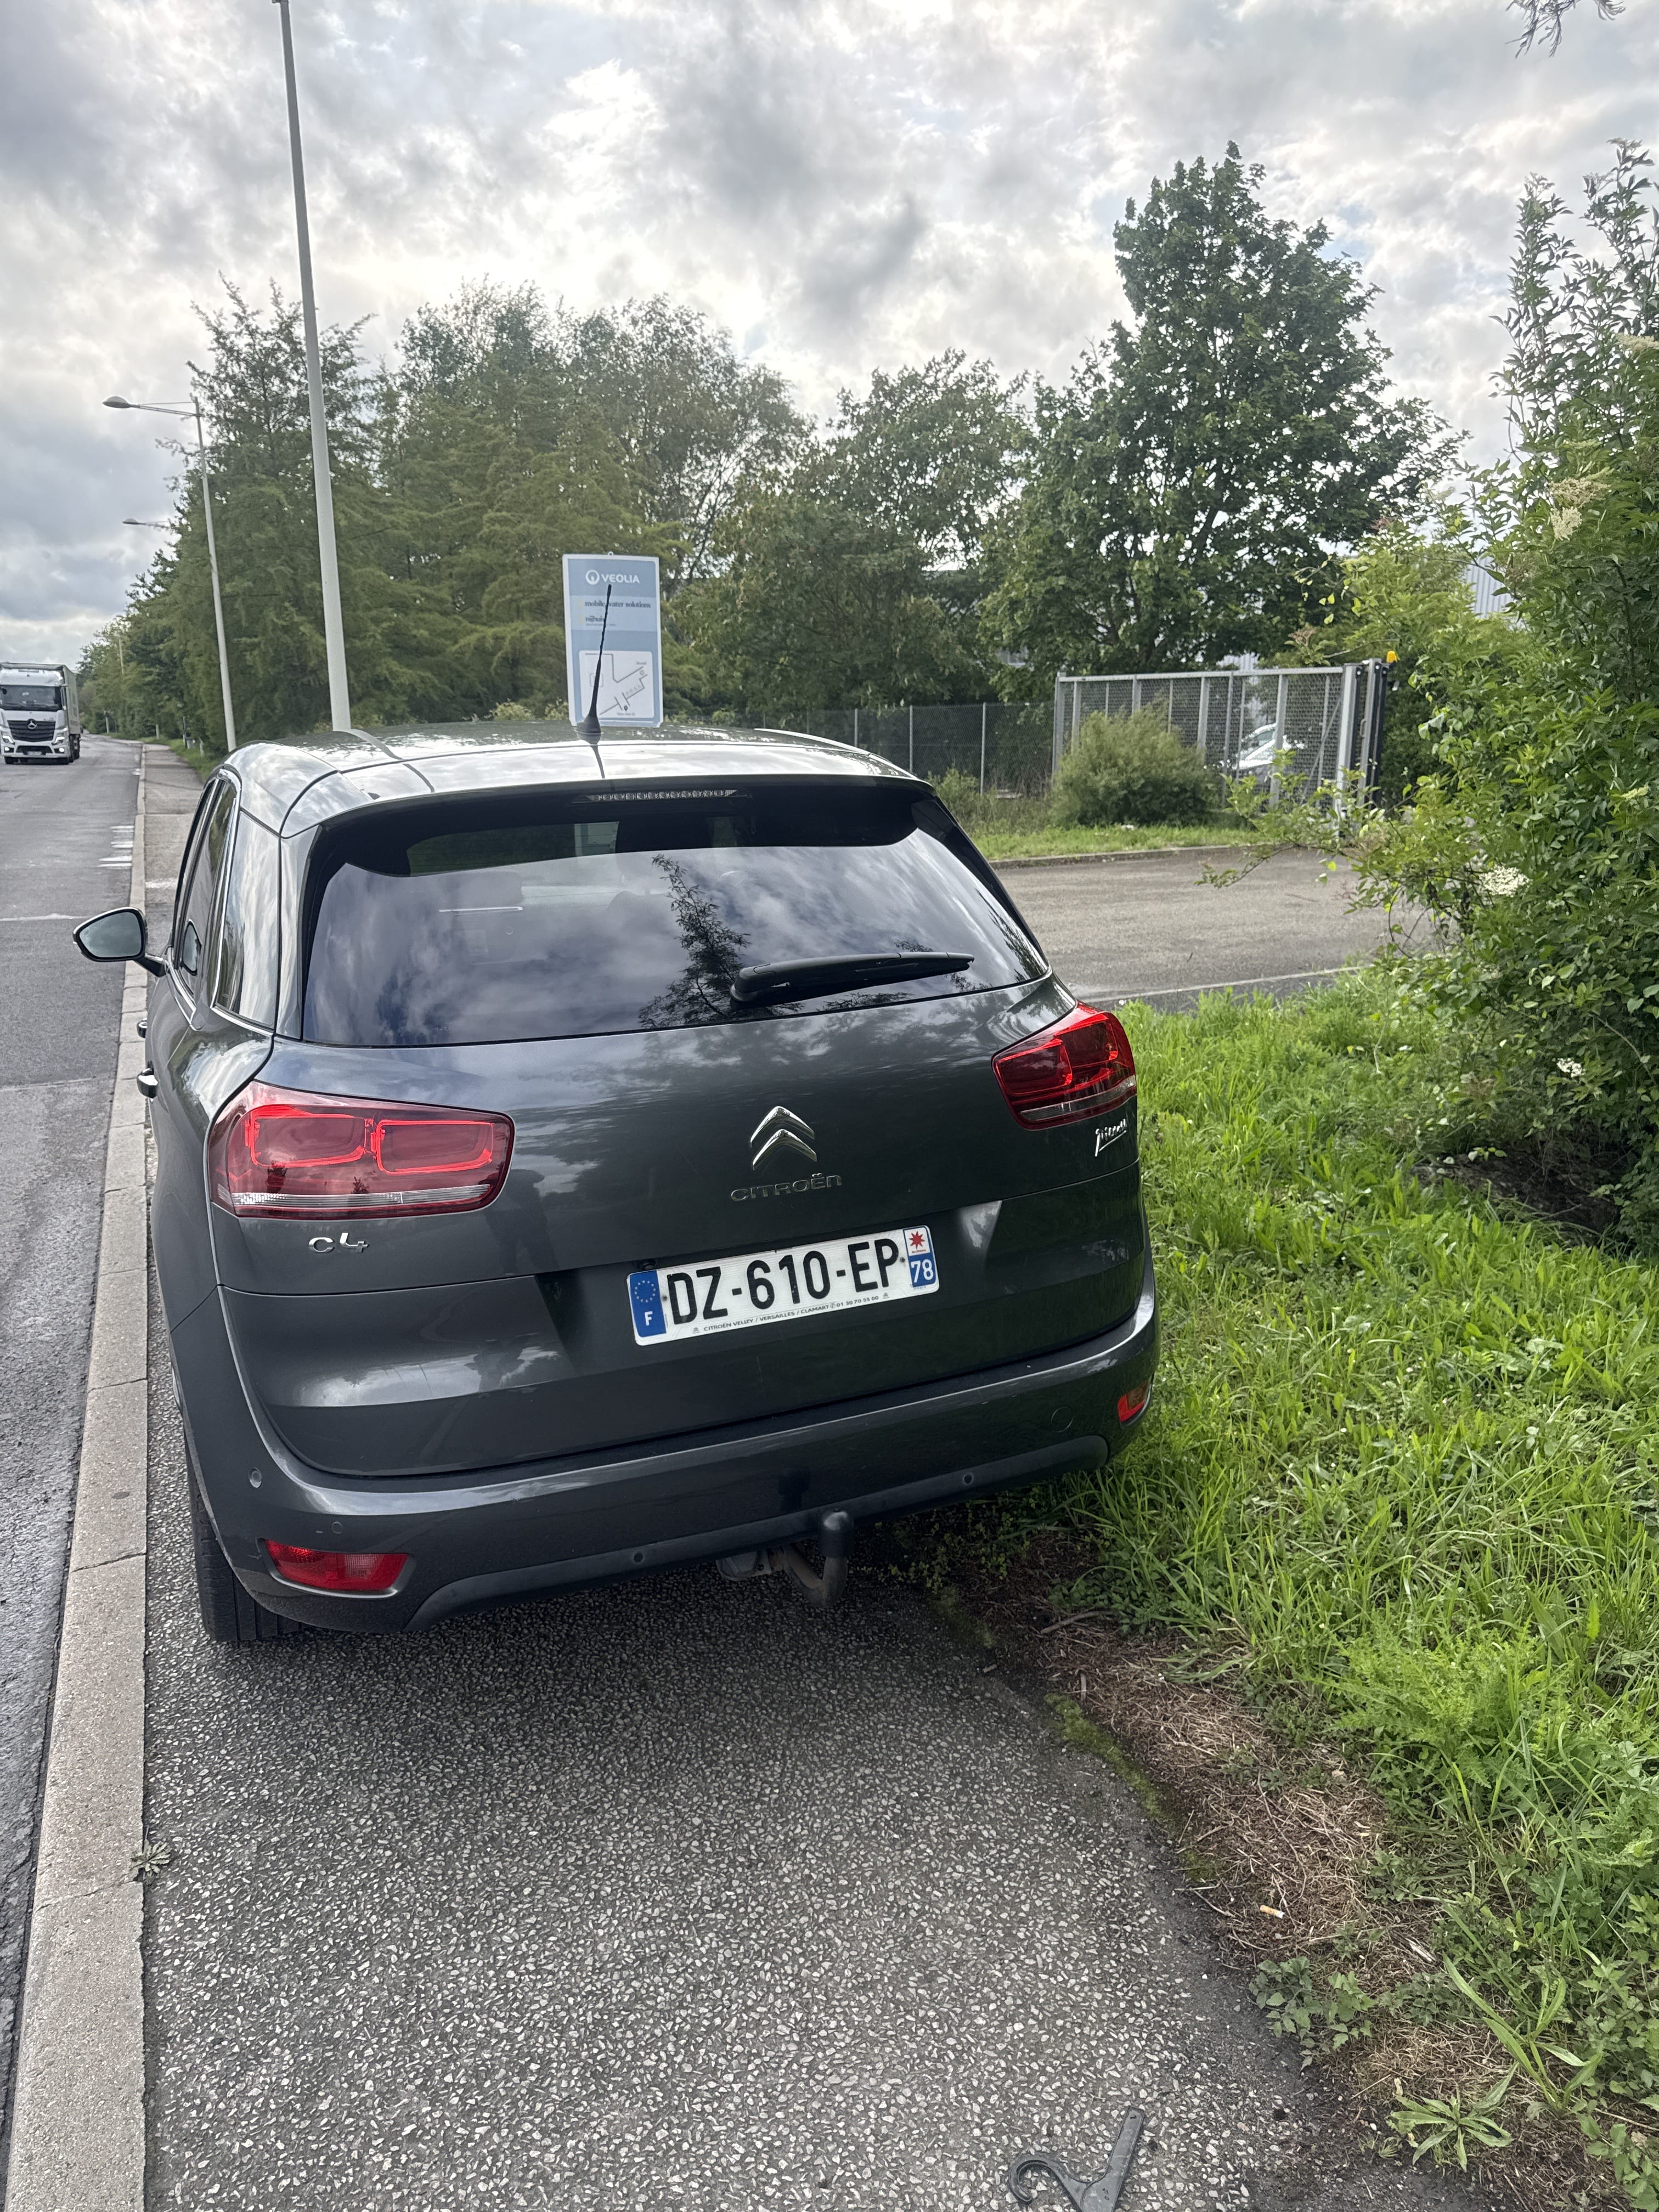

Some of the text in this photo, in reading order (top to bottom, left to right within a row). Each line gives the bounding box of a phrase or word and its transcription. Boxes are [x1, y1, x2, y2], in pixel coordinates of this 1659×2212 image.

[601, 573, 640, 583] VEOLIA
[308, 1232, 368, 1253] C4
[644, 1311, 653, 1326] F
[667, 1238, 899, 1325] DZ-610-EP
[911, 1259, 934, 1283] 78
[759, 1312, 795, 1321] VERSAILLES
[800, 1305, 829, 1314] CLAMART
